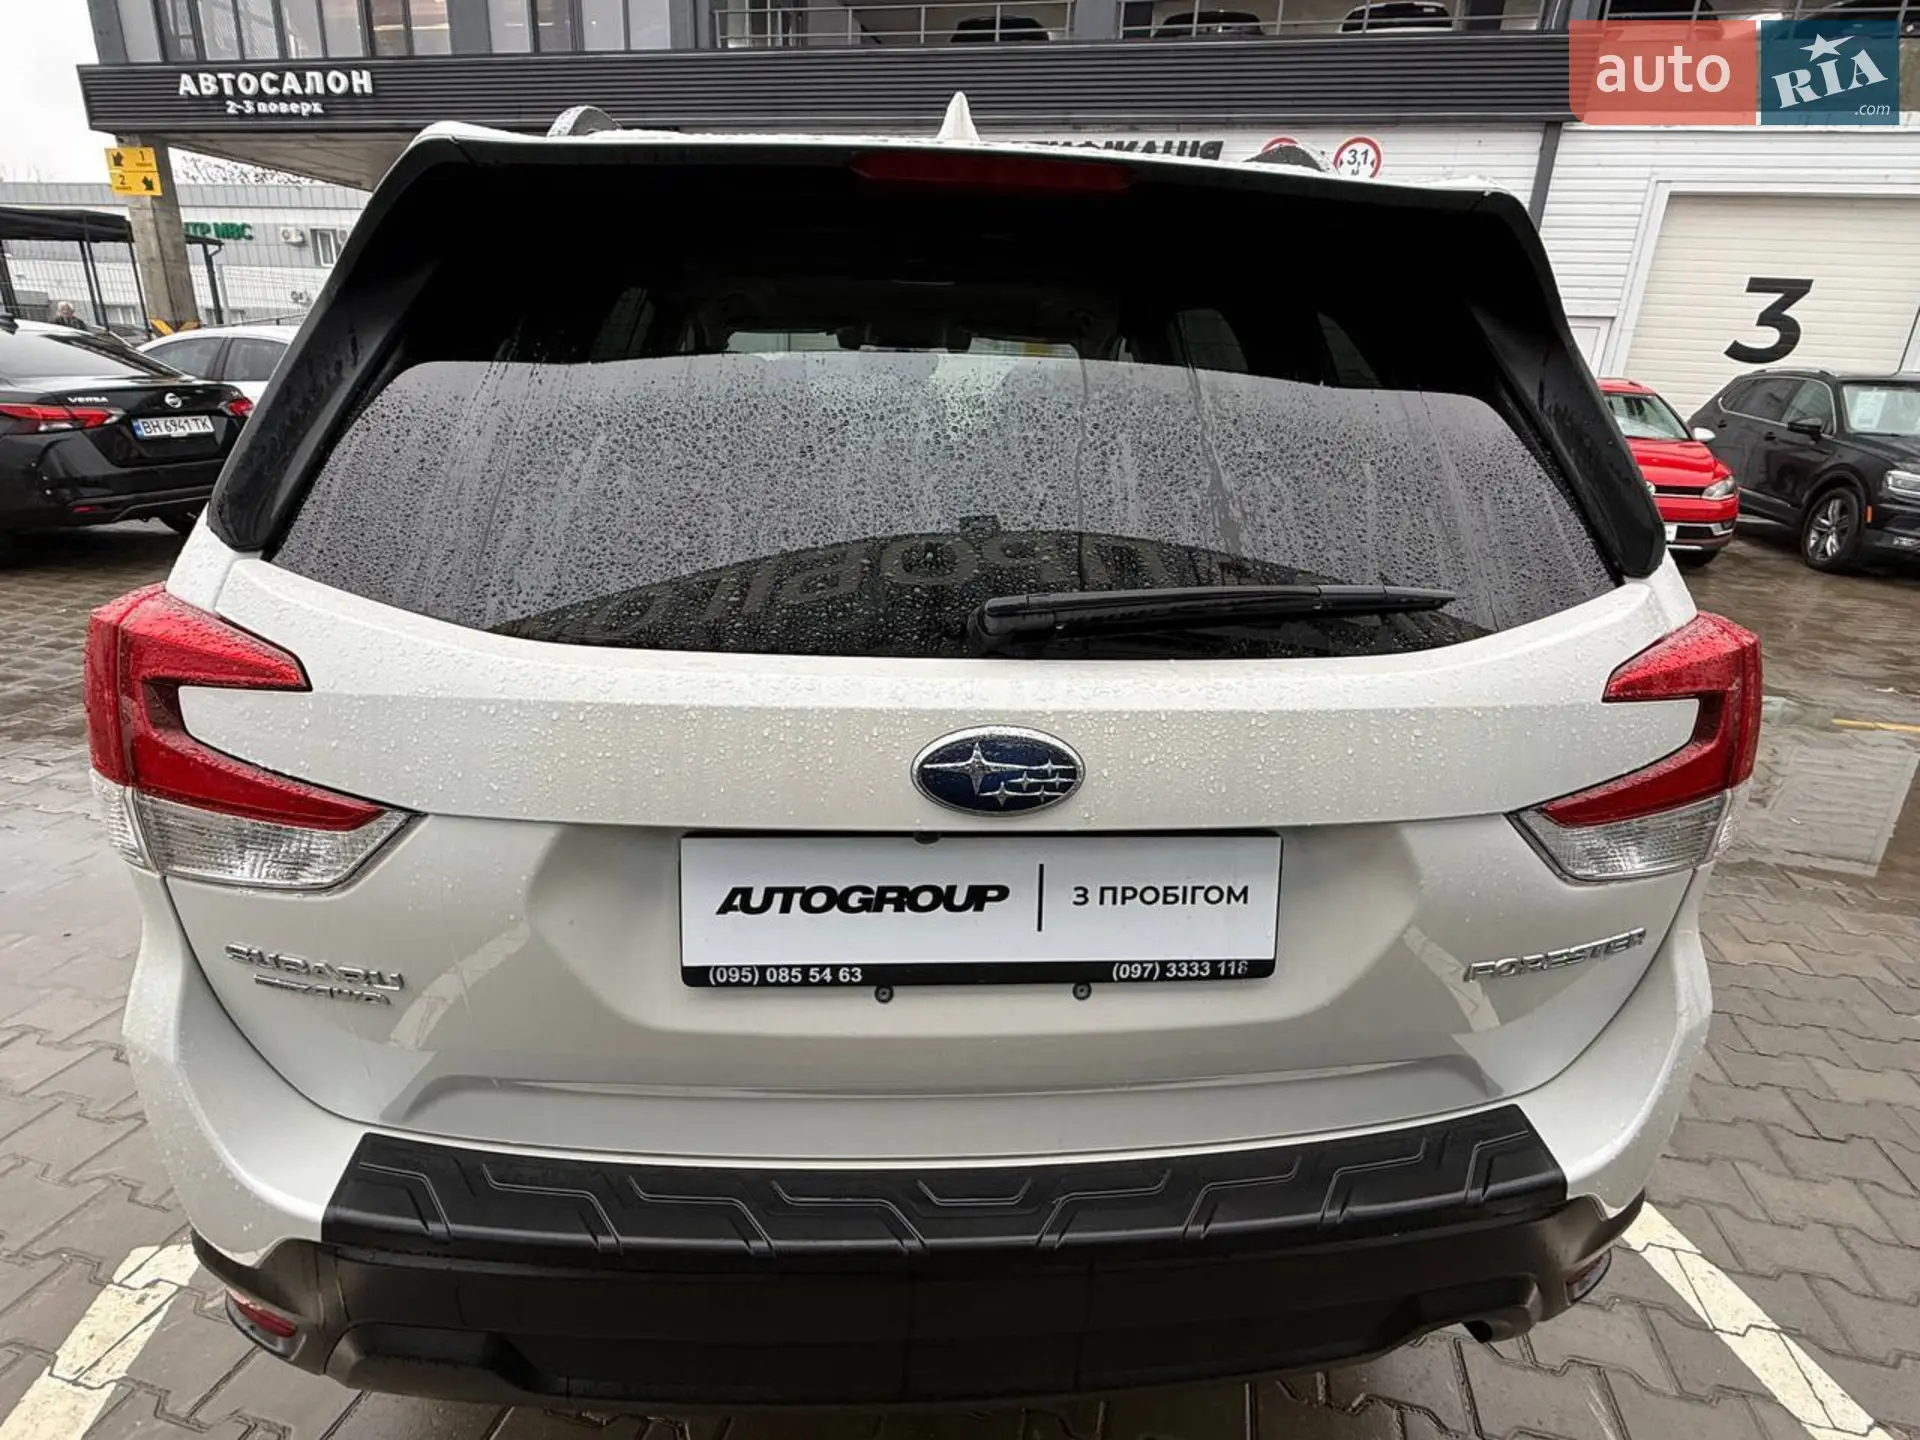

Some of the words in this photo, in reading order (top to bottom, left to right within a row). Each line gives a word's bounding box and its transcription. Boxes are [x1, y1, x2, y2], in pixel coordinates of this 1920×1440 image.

[178, 69, 374, 96] АВТОСАЛОН
[226, 100, 254, 115] 2-3
[257, 101, 325, 117] поверх
[1347, 148, 1370, 169] 3,1
[119, 173, 127, 186] 2
[1723, 276, 1815, 364] 3
[164, 418, 193, 433] 6941
[715, 884, 1011, 916] AUTOGROUP
[1072, 885, 1090, 907] З
[1098, 885, 1249, 906] ПРОБІГОМ
[1463, 926, 1647, 983] FORESTER
[225, 942, 404, 991] SUBARU
[708, 965, 760, 986] (095)
[766, 966, 802, 983] 085
[808, 966, 833, 983] 54
[838, 966, 863, 983] 63
[1112, 960, 1160, 981] (097)
[1165, 961, 1211, 978] 3333
